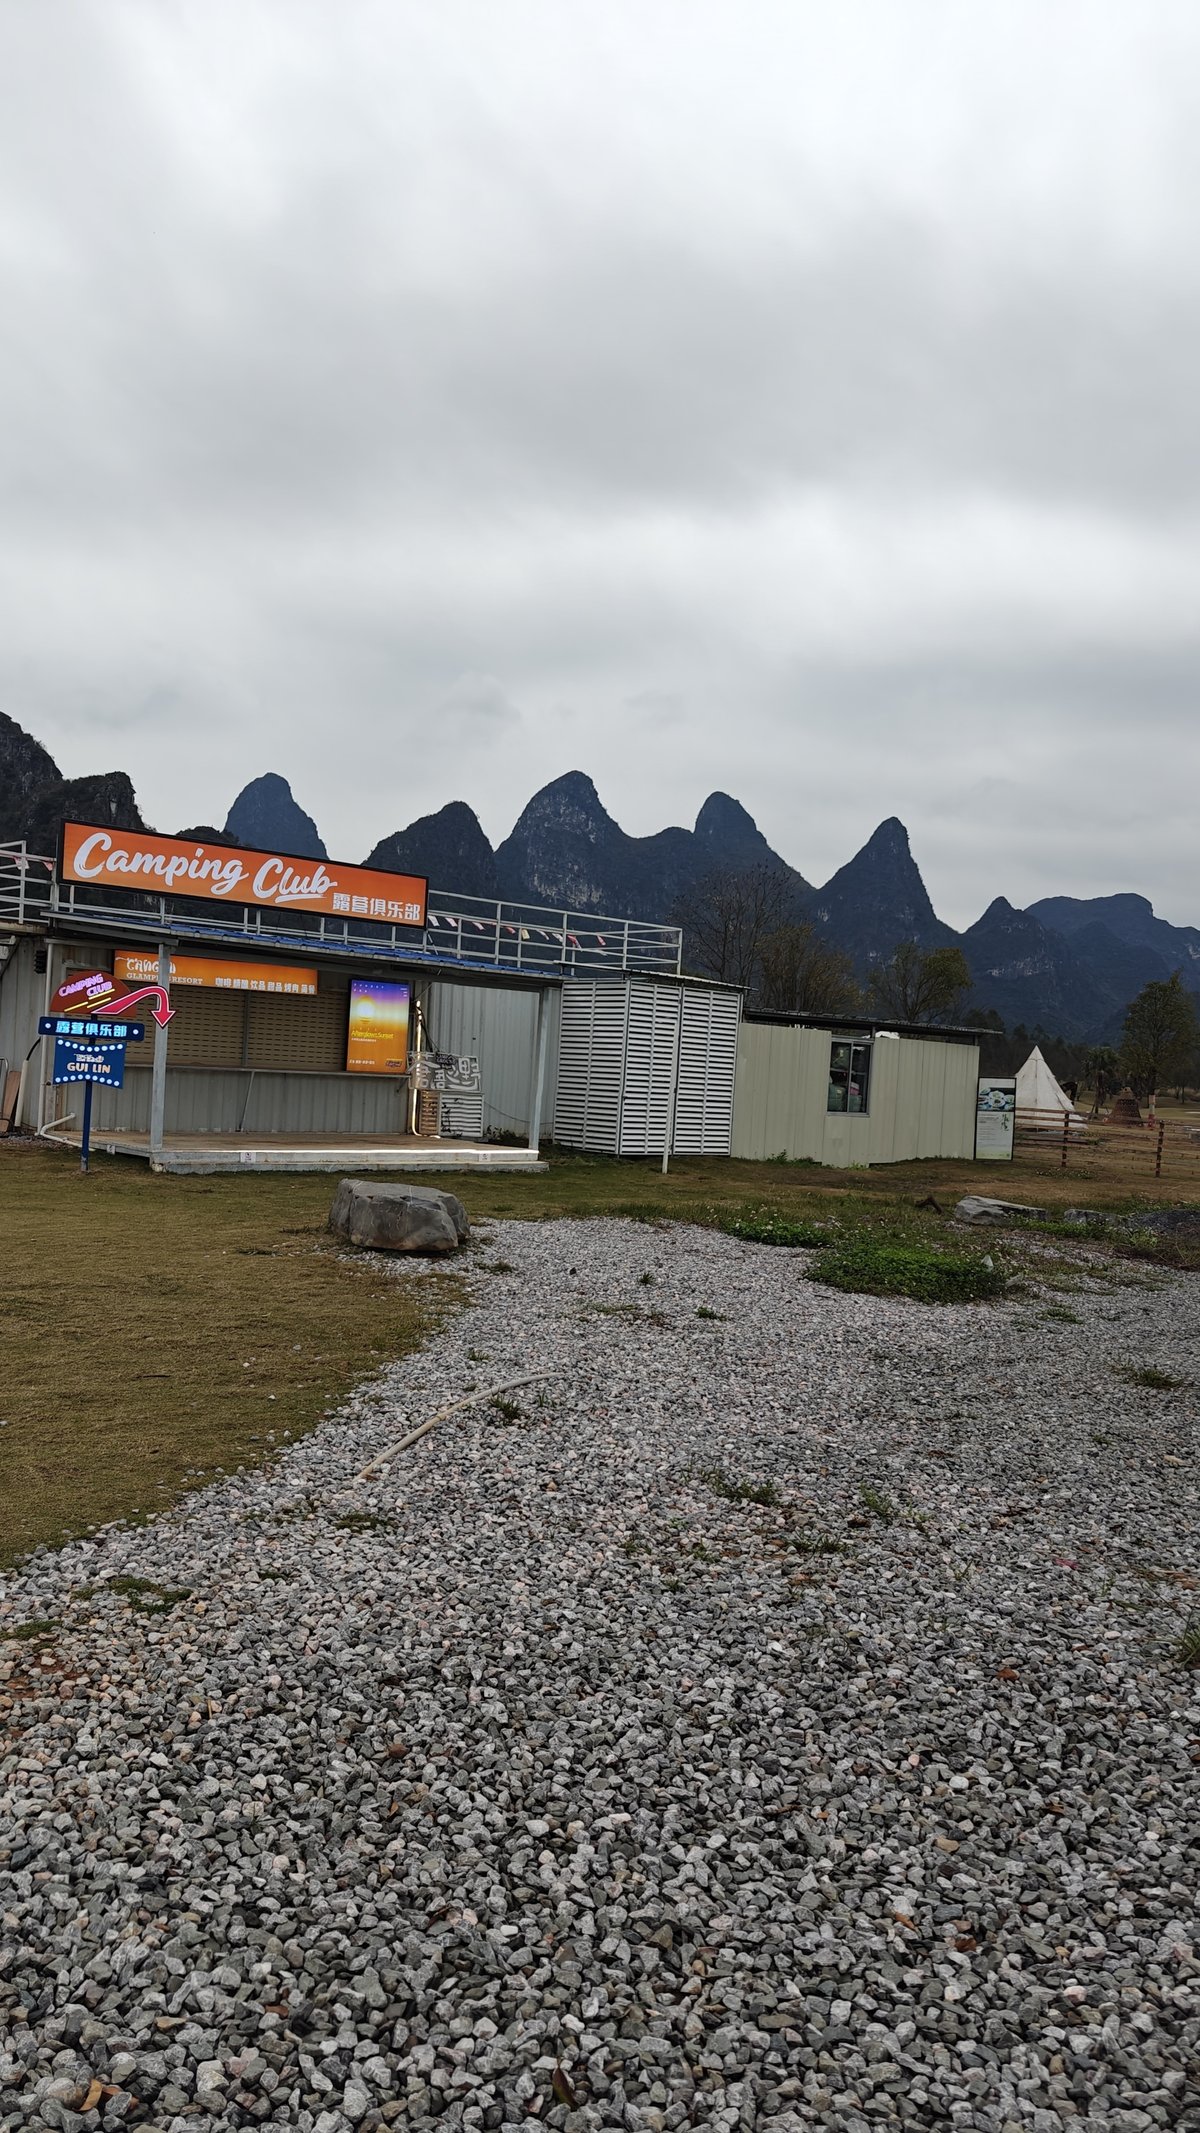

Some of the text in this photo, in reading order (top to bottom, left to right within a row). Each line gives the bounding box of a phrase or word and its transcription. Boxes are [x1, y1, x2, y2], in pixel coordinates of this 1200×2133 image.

[73, 832, 337, 902] Camping Club
[333, 892, 420, 920] 露营俱乐部
[58, 973, 104, 997] CAMPING
[86, 981, 113, 997] CLUB
[172, 976, 204, 985] RESORT
[55, 1020, 128, 1038] 露营俱乐部
[66, 1062, 89, 1073] GUI
